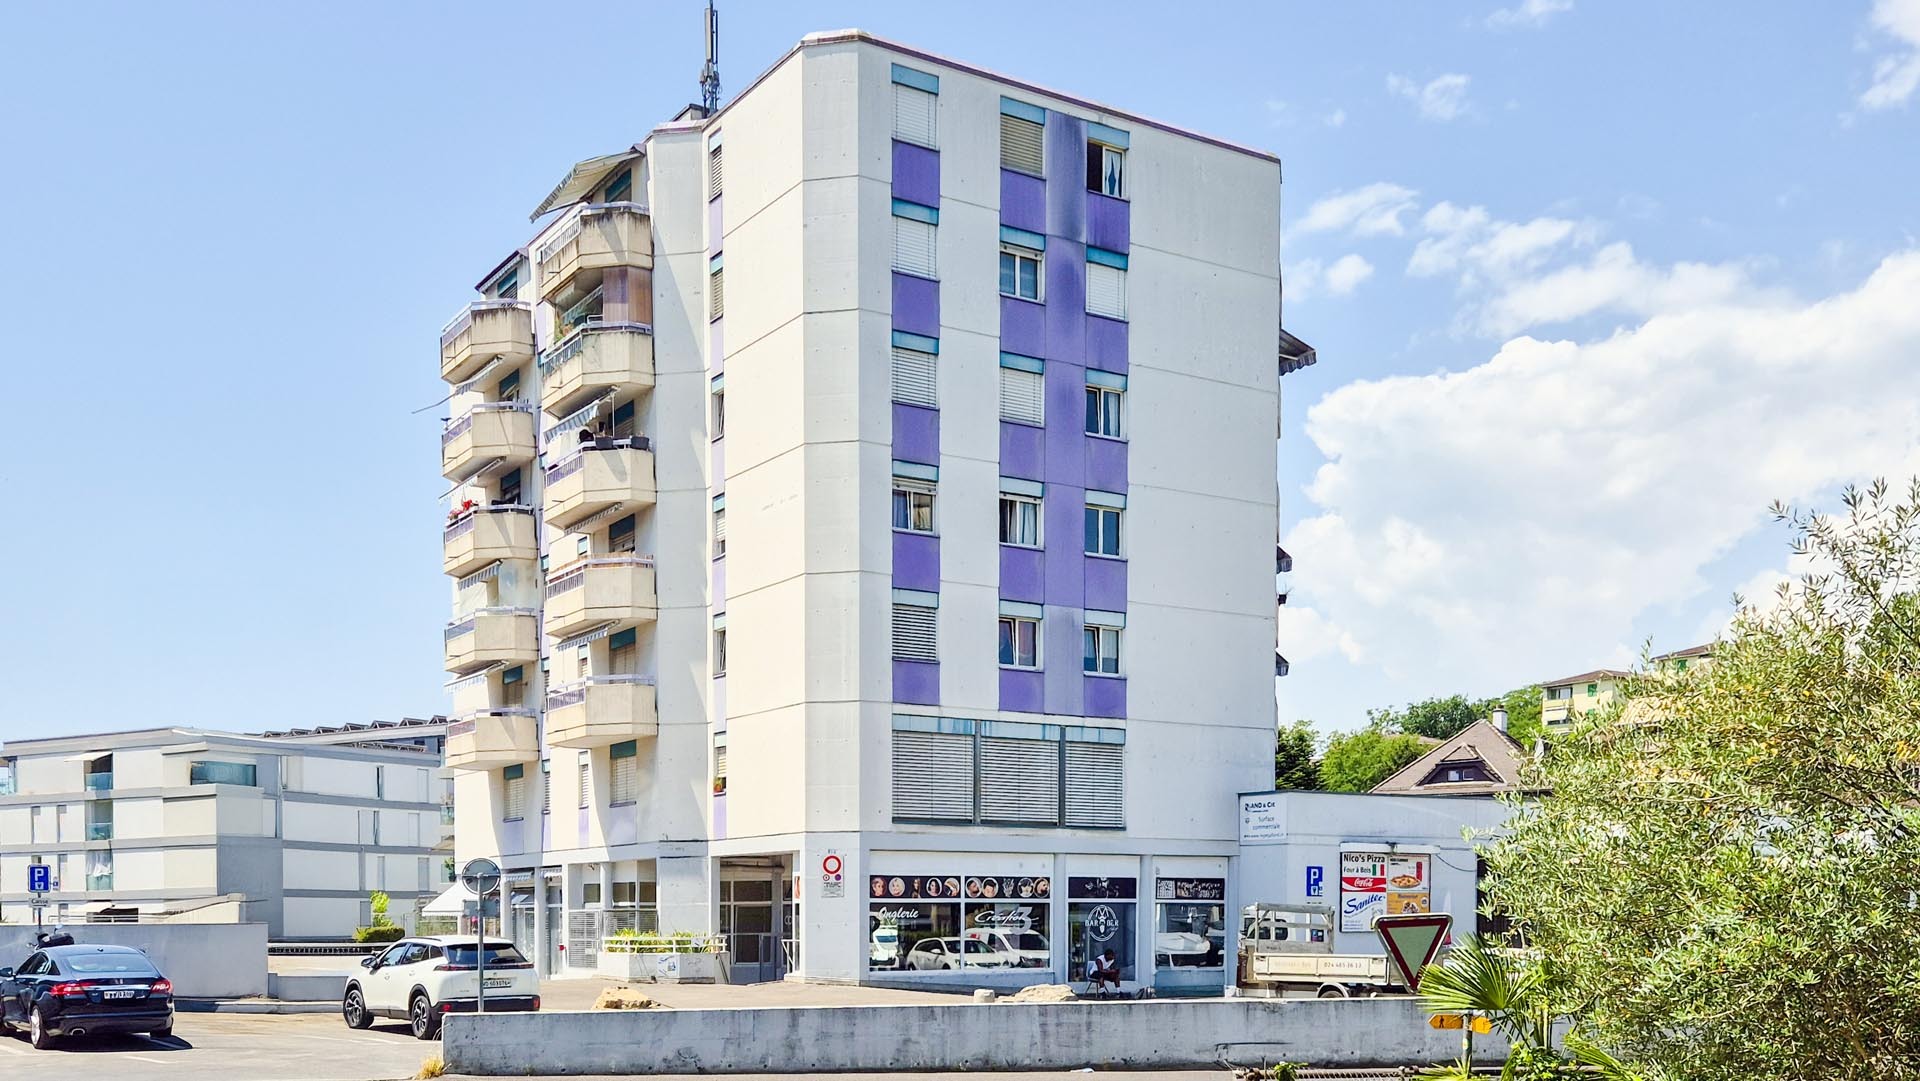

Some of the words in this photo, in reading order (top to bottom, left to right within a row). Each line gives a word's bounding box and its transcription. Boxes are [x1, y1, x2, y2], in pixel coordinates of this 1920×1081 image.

[1343, 853, 1366, 862] Nico's
[1366, 853, 1386, 863] Pizza
[34, 868, 45, 882] P
[1310, 868, 1319, 885] P
[878, 906, 919, 923] Onglerie
